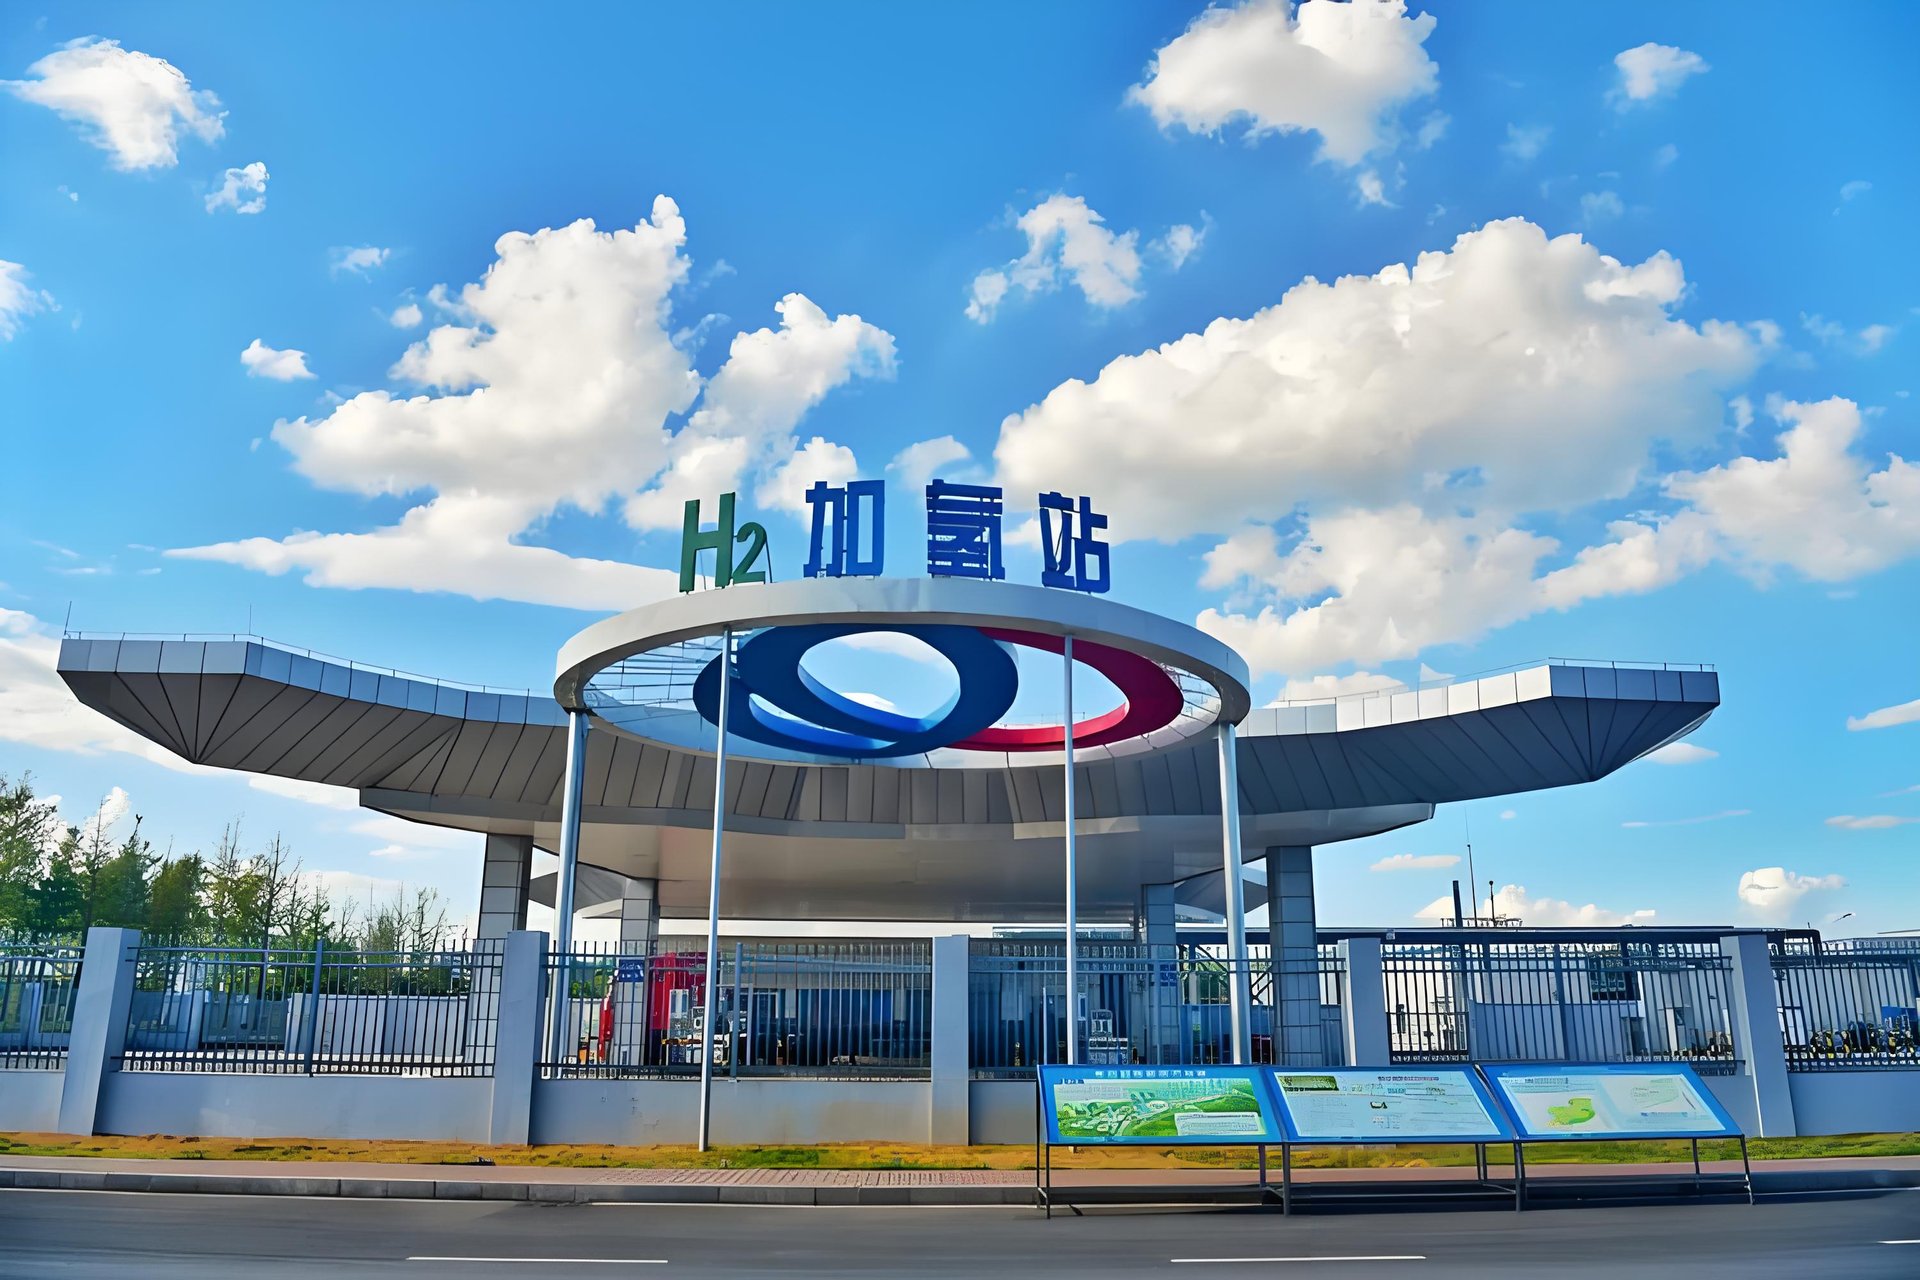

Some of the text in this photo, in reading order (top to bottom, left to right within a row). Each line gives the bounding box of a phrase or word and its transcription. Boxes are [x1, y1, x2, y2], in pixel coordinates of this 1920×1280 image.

[680, 479, 1110, 593] H2 加氢站
